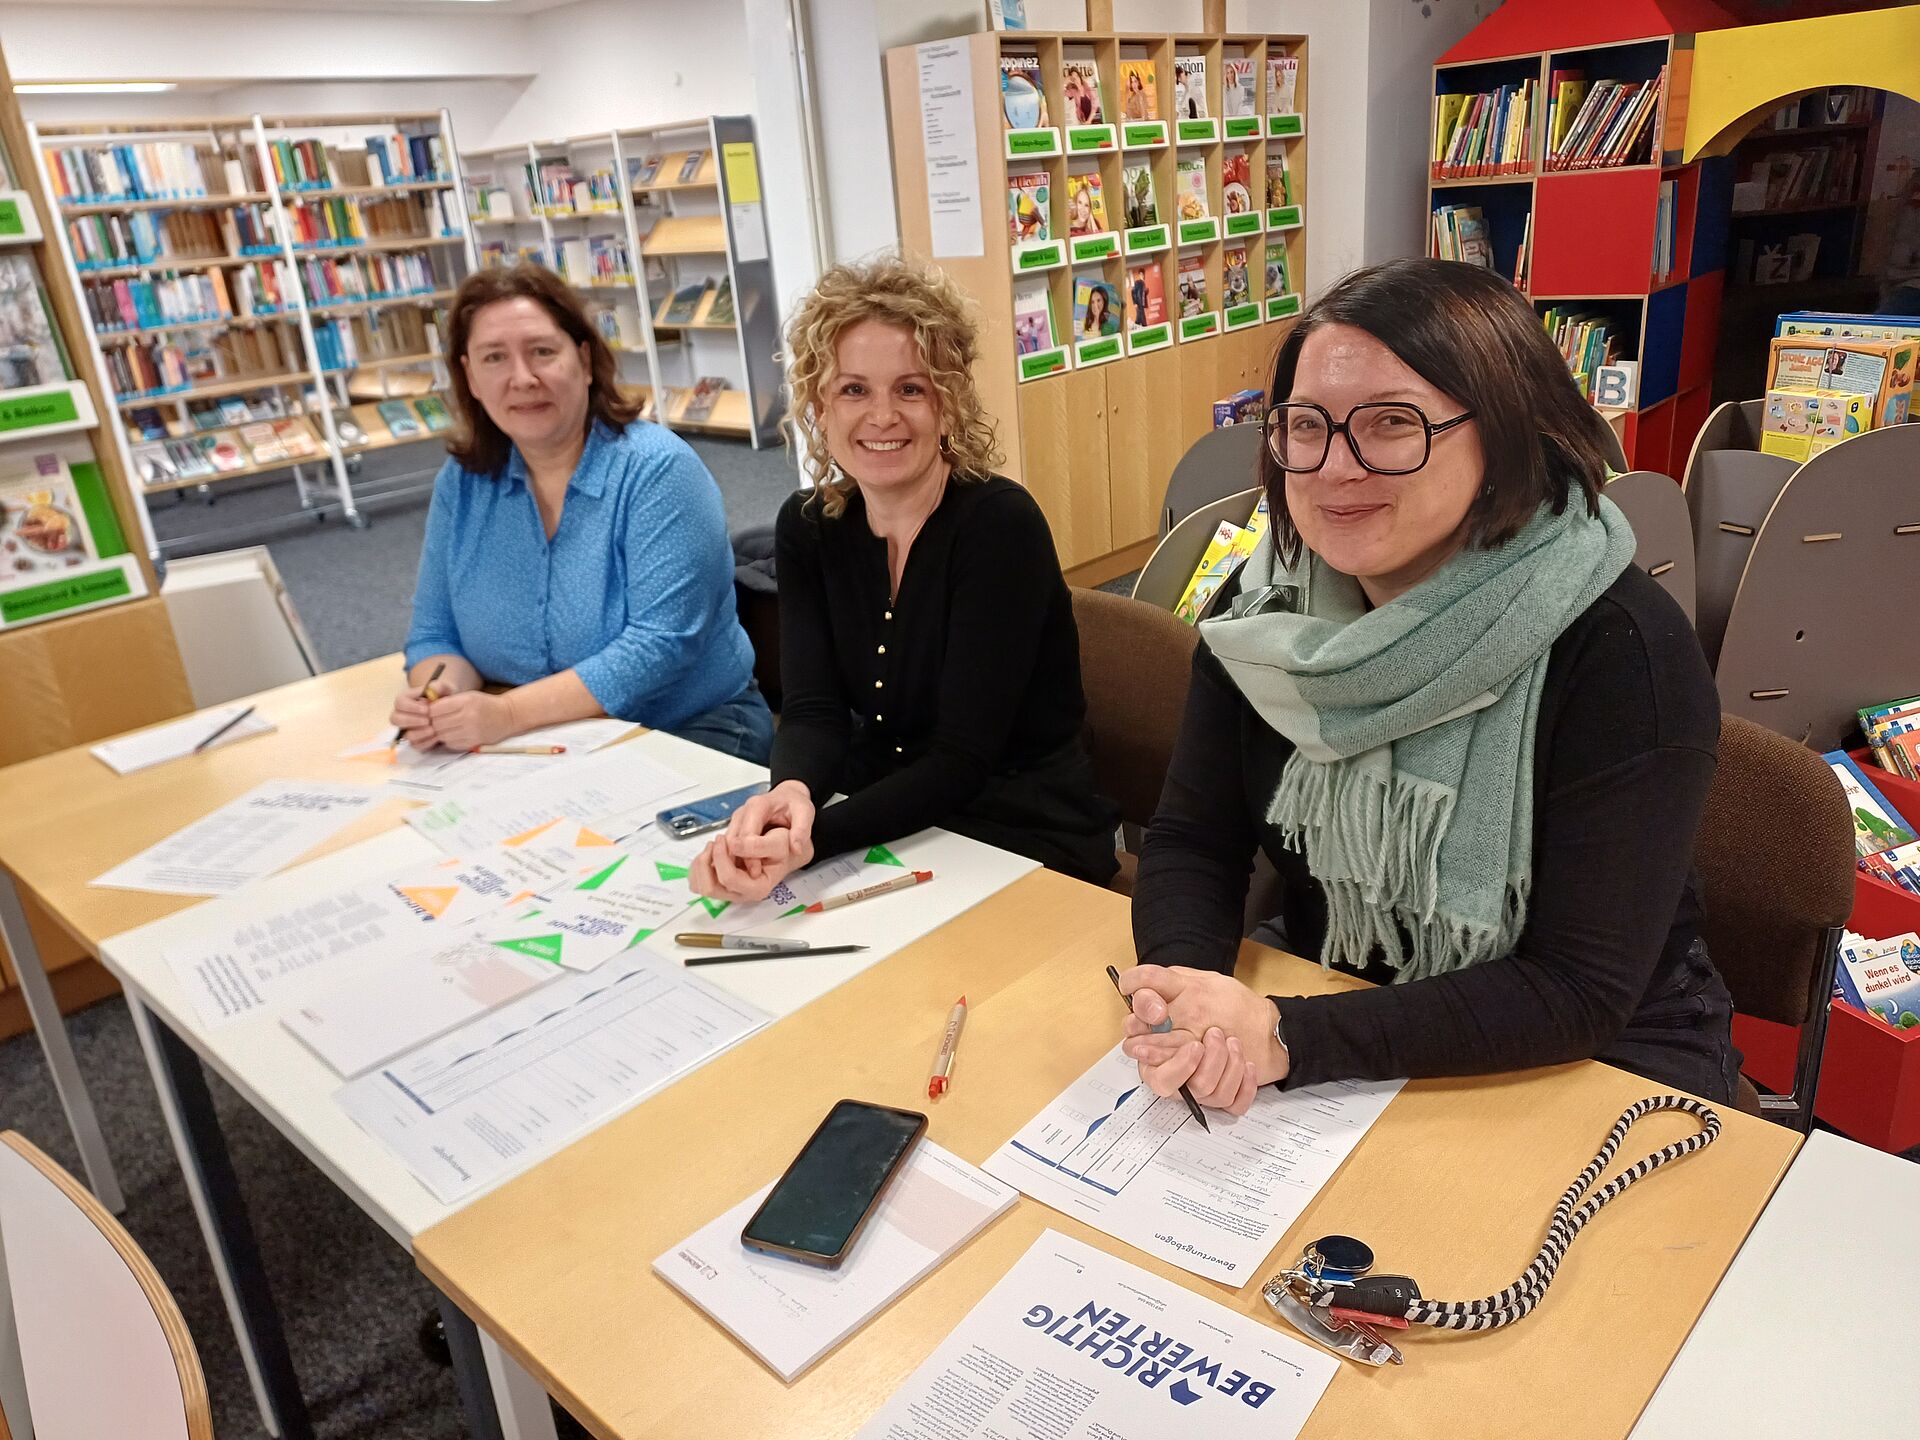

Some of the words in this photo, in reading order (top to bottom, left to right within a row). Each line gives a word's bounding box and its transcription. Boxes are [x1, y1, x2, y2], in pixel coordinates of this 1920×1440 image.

[1598, 369, 1627, 405] B
[1864, 967, 1889, 980] Wenn
[1889, 964, 1900, 974] es
[1865, 977, 1893, 993] dunkel
[1892, 972, 1911, 987] wird
[1154, 1232, 1236, 1271] Bewertungsbogen
[1022, 1304, 1171, 1389] RICHTIG
[1073, 1300, 1277, 1409] BEWERTEN
